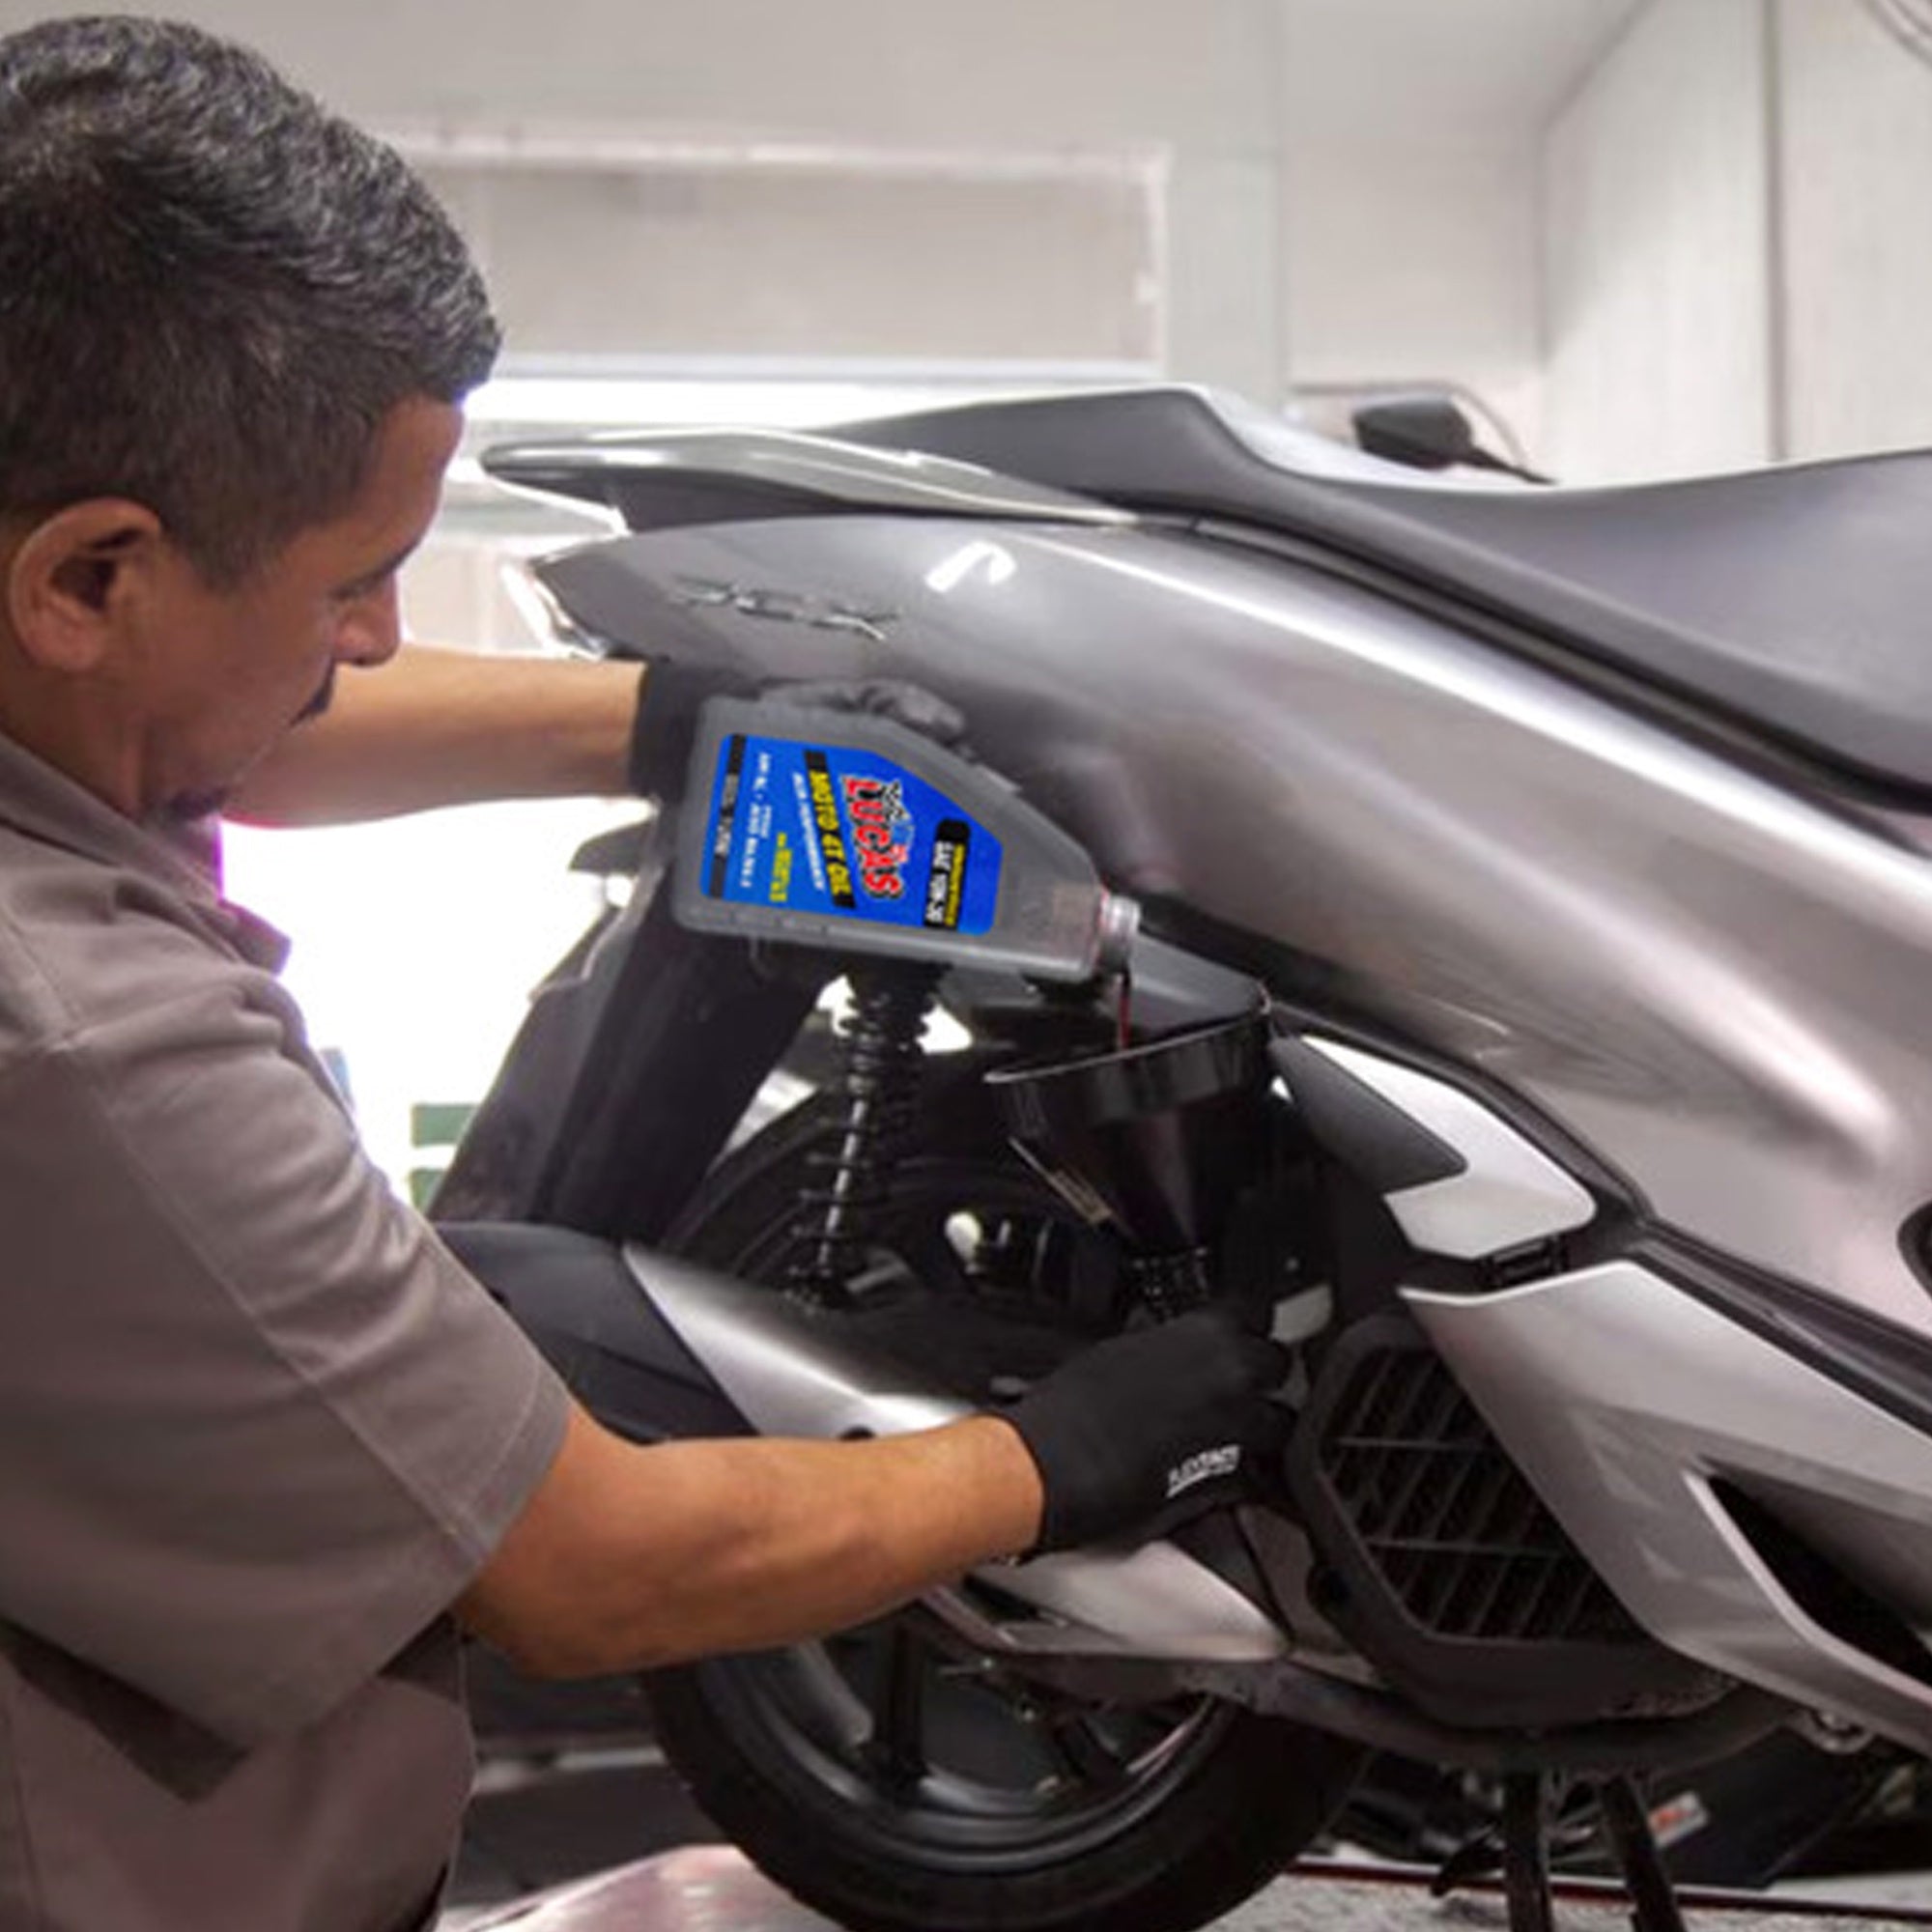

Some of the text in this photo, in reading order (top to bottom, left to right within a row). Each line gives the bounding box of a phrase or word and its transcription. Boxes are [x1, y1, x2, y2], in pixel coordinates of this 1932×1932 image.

[809, 771, 853, 896] MOTO 4T OIL
[841, 776, 904, 898] LUCAS
